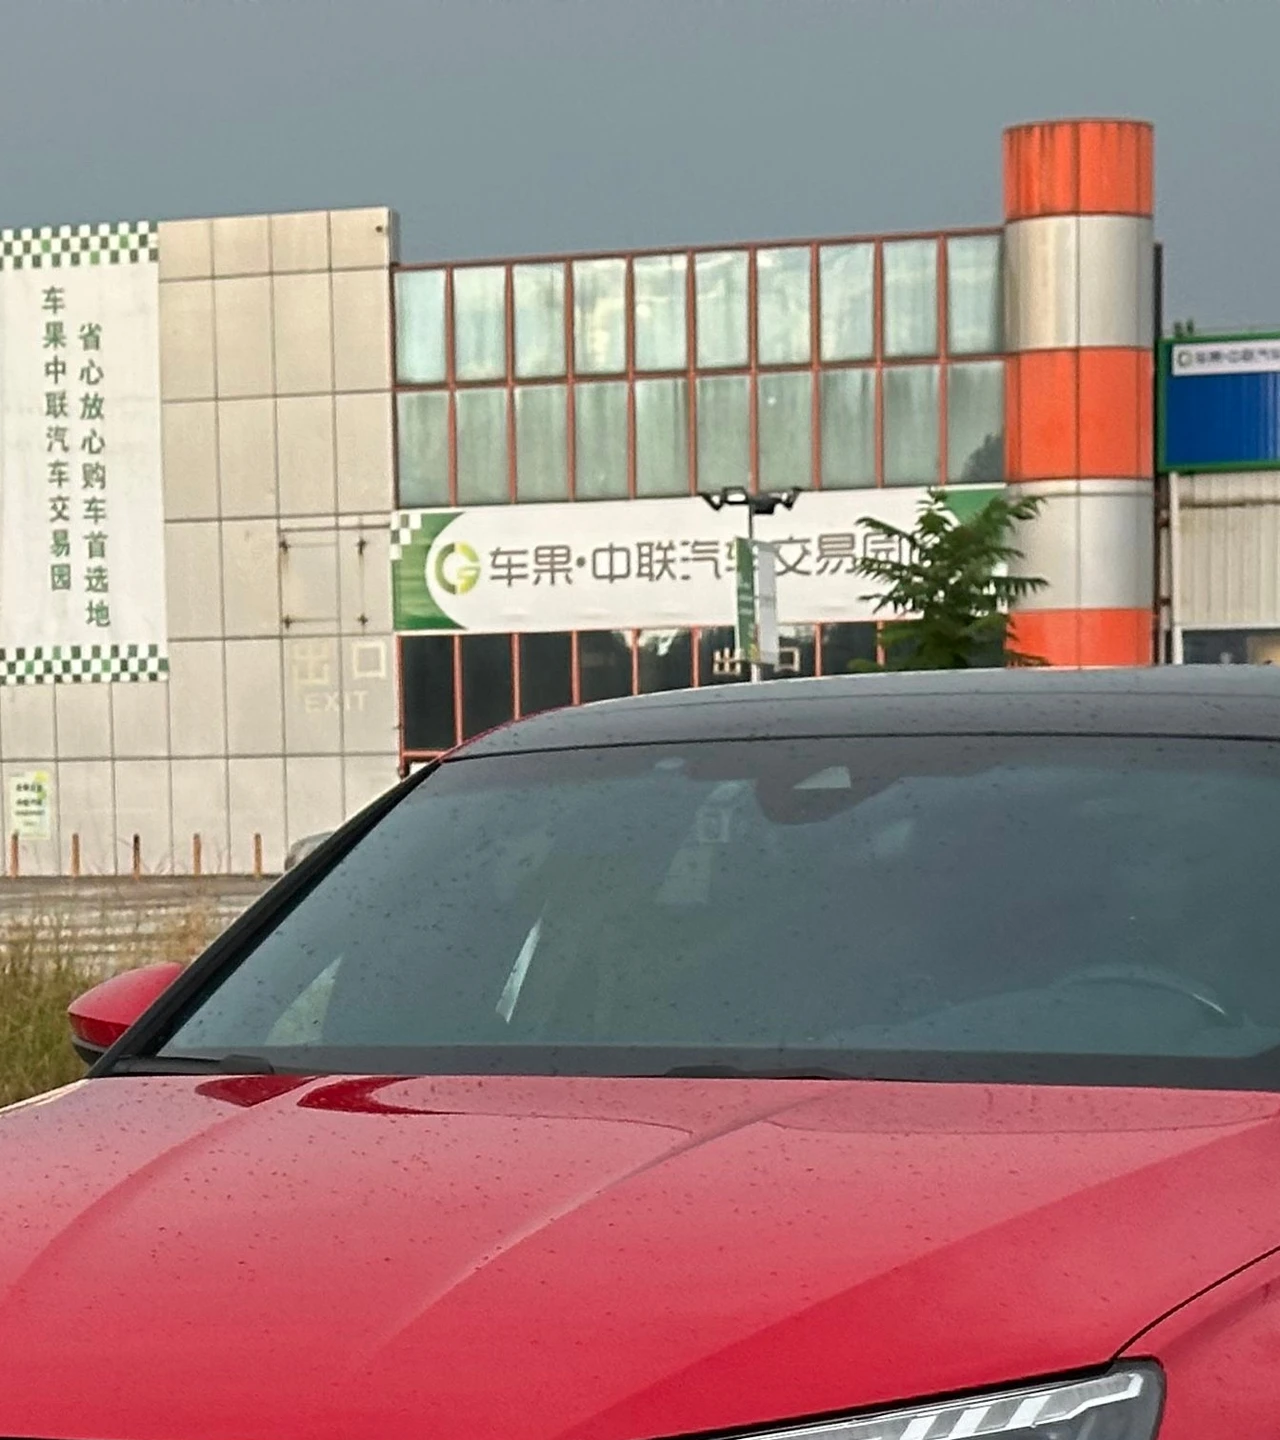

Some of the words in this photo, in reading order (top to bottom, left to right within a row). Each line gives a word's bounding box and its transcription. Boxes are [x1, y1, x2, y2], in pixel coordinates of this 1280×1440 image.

[42, 286, 71, 591] 车果中联汽车交易园
[78, 323, 111, 628] 省心放心购车首选地
[305, 690, 368, 713] EXIT
